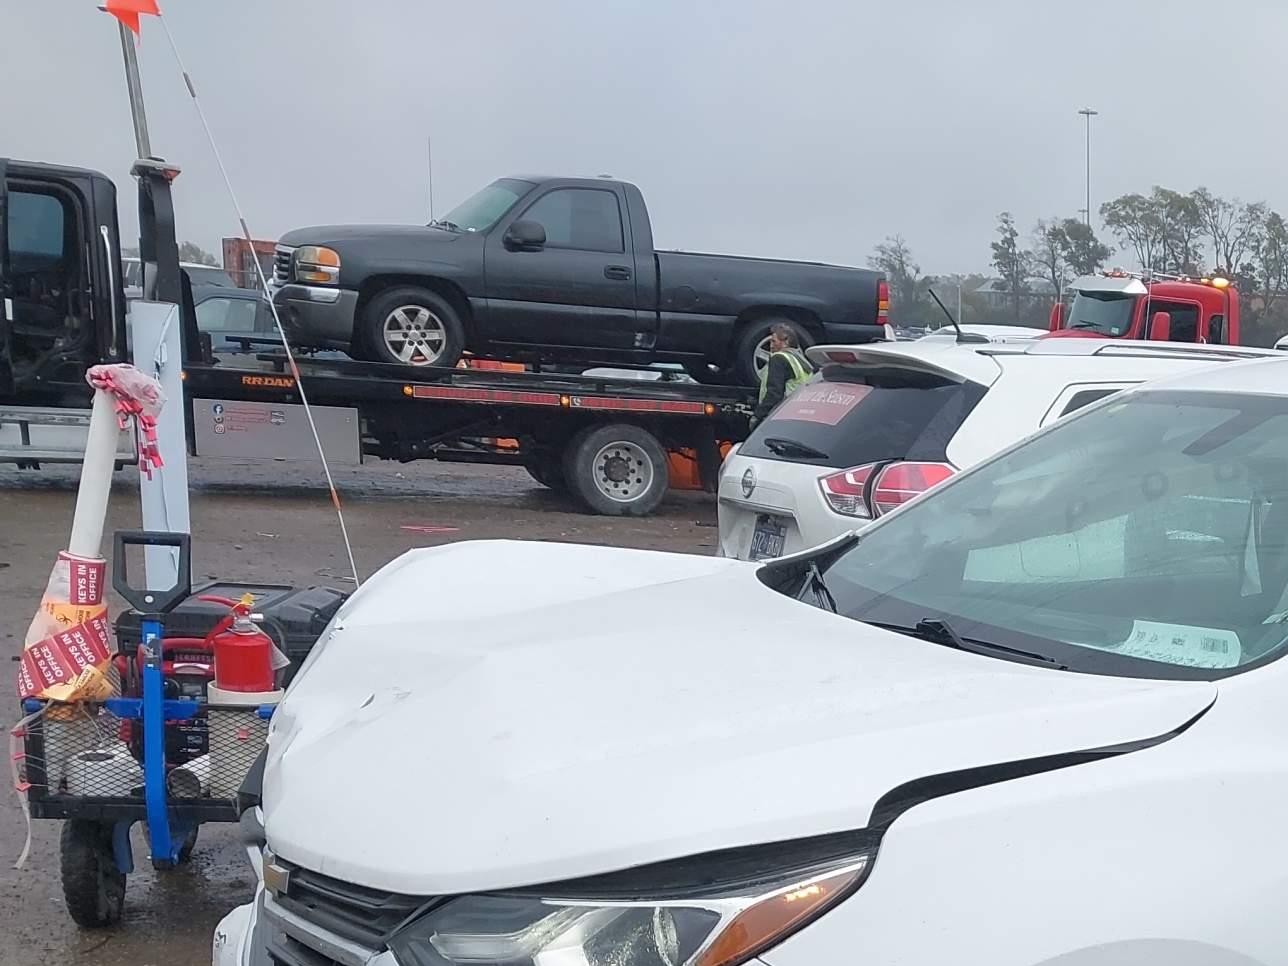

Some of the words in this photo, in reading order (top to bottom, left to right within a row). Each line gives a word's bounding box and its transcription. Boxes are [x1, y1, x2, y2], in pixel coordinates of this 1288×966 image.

[78, 564, 87, 575] IN
[78, 576, 87, 603] KEYS
[89, 567, 97, 601] OFFICE
[31, 647, 42, 657] IN
[61, 633, 73, 645] IN
[72, 630, 96, 663] OFFICE
[37, 658, 56, 684] KEYS
[40, 645, 64, 678] OFFICE
